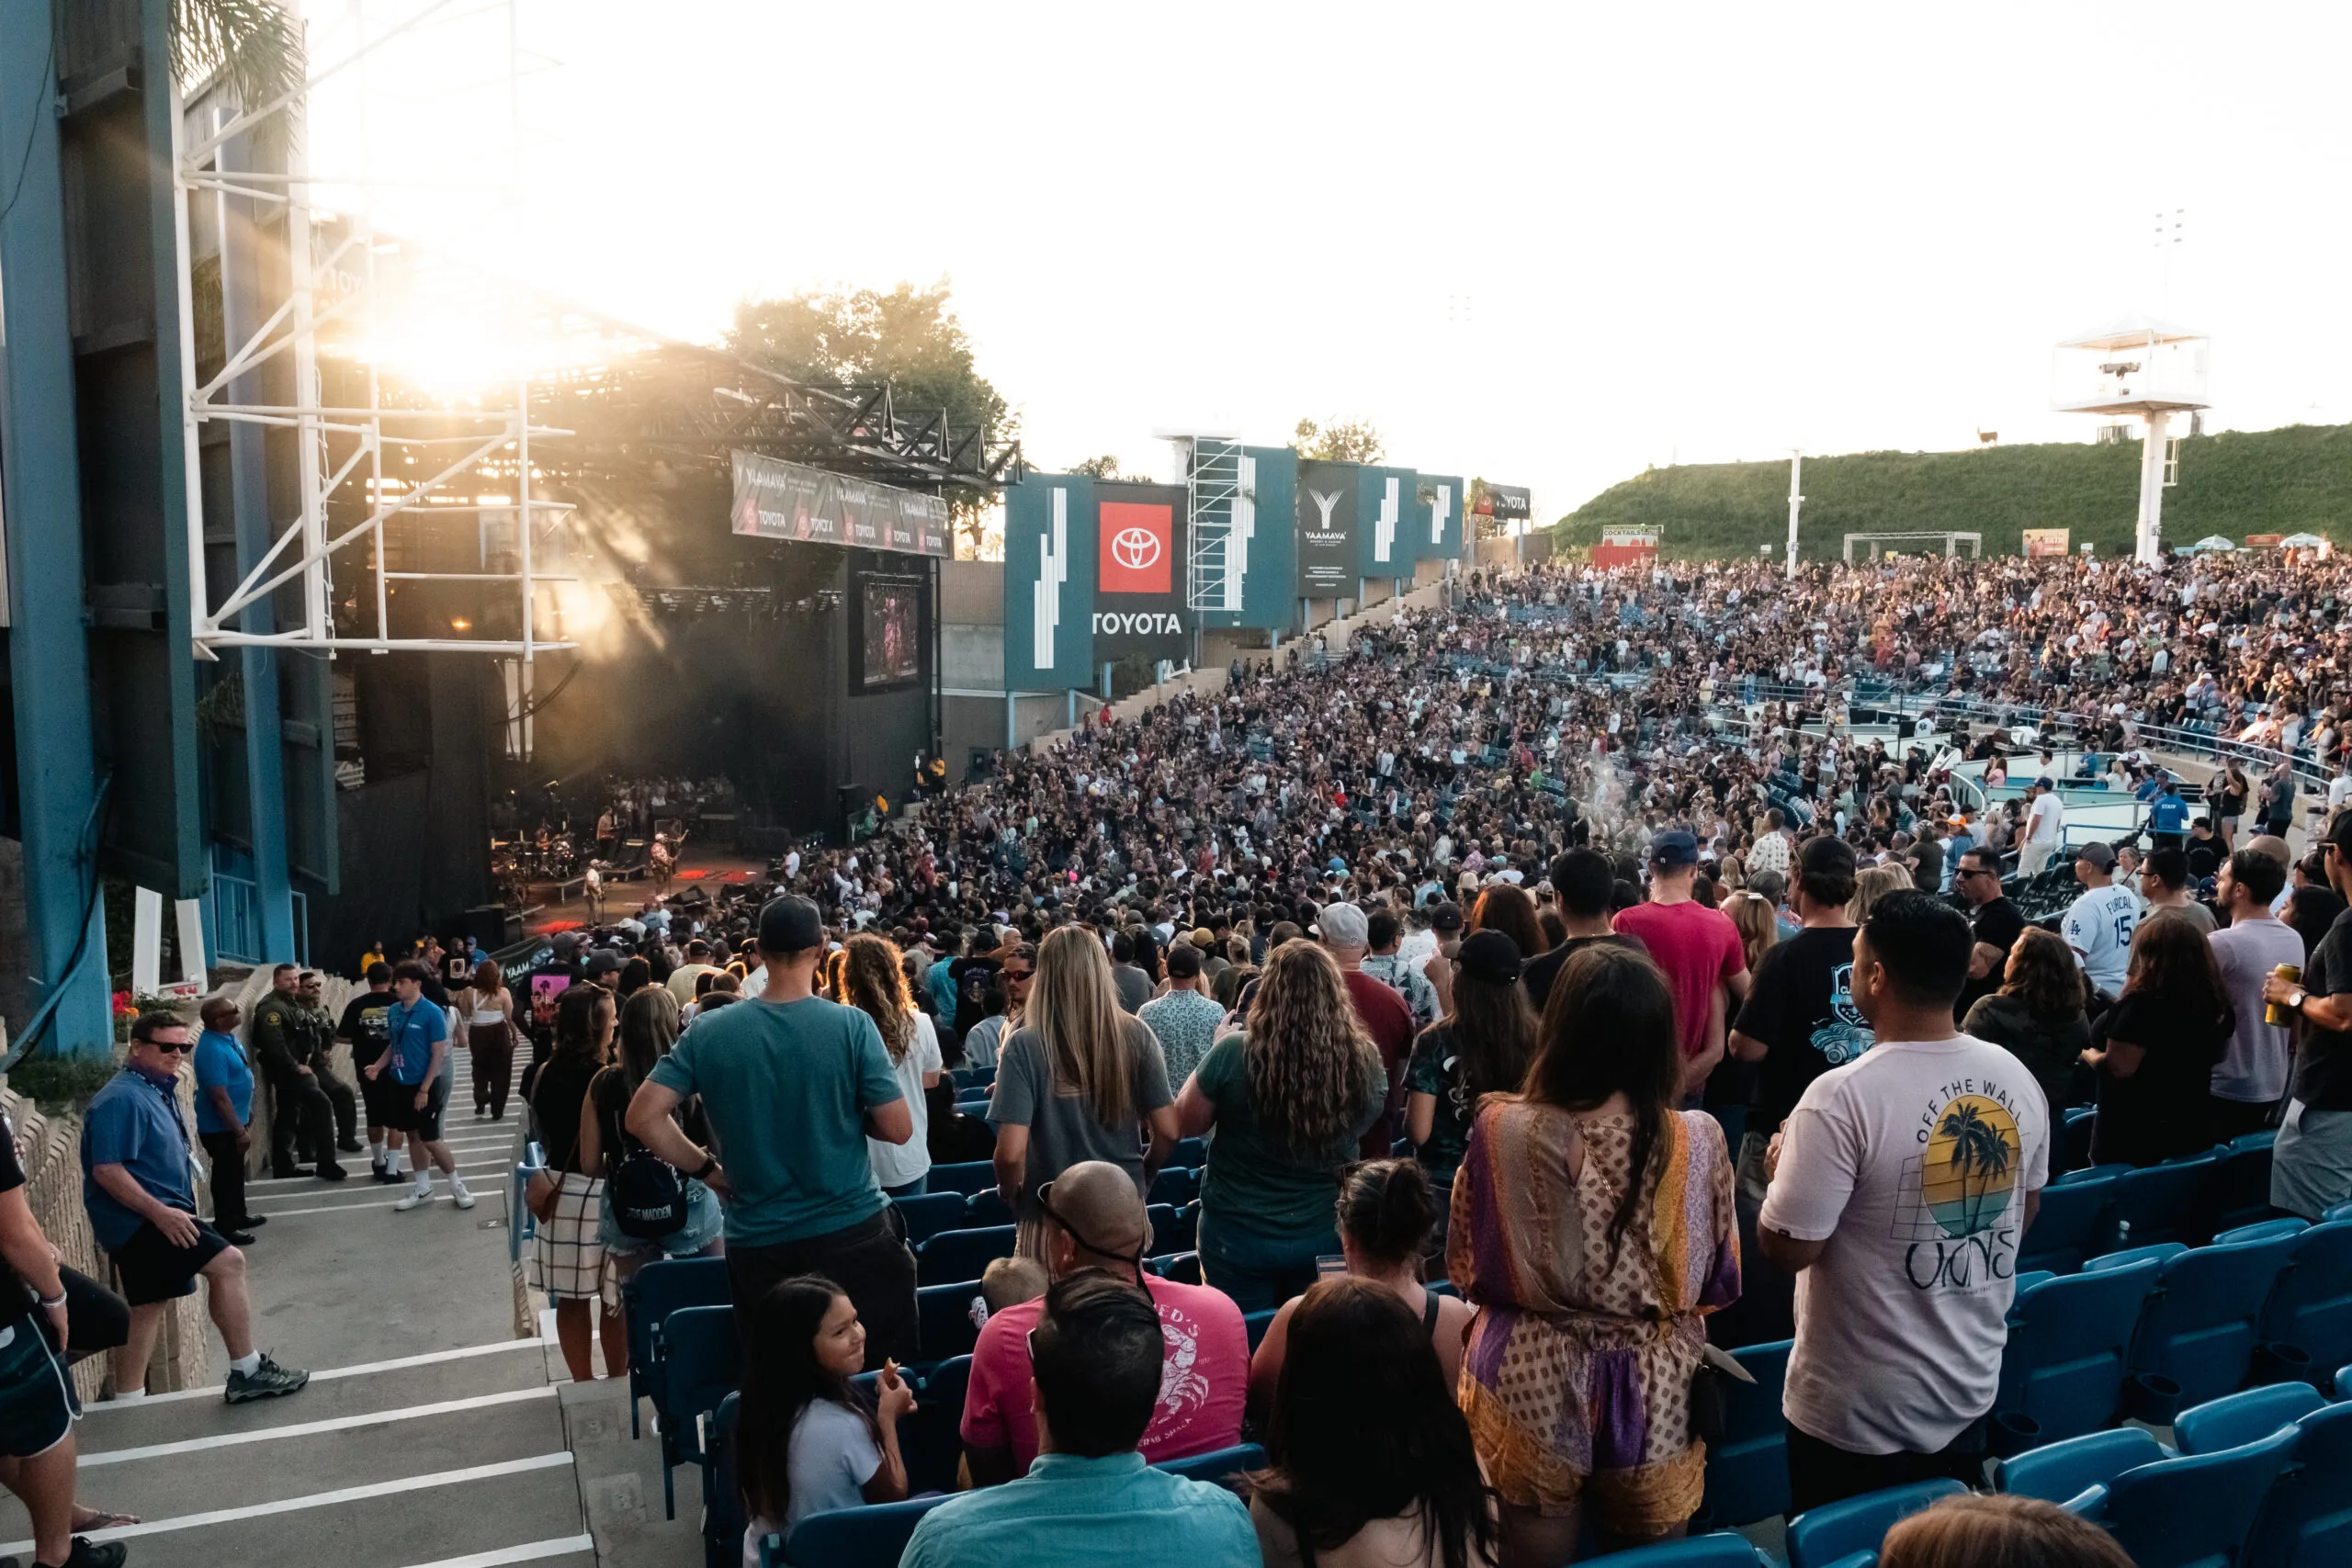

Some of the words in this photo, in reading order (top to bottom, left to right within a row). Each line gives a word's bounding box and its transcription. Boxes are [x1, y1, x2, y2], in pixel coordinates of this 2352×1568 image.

[758, 510, 786, 527] TOYOTA
[1092, 612, 1182, 635] TOYOTA
[2105, 896, 2133, 916] FURCAL
[2114, 915, 2132, 949] 15
[505, 961, 536, 979] YAAM
[1916, 1100, 1939, 1145] OFF
[1939, 1078, 1974, 1101] THE
[1983, 1079, 2023, 1127] WALL
